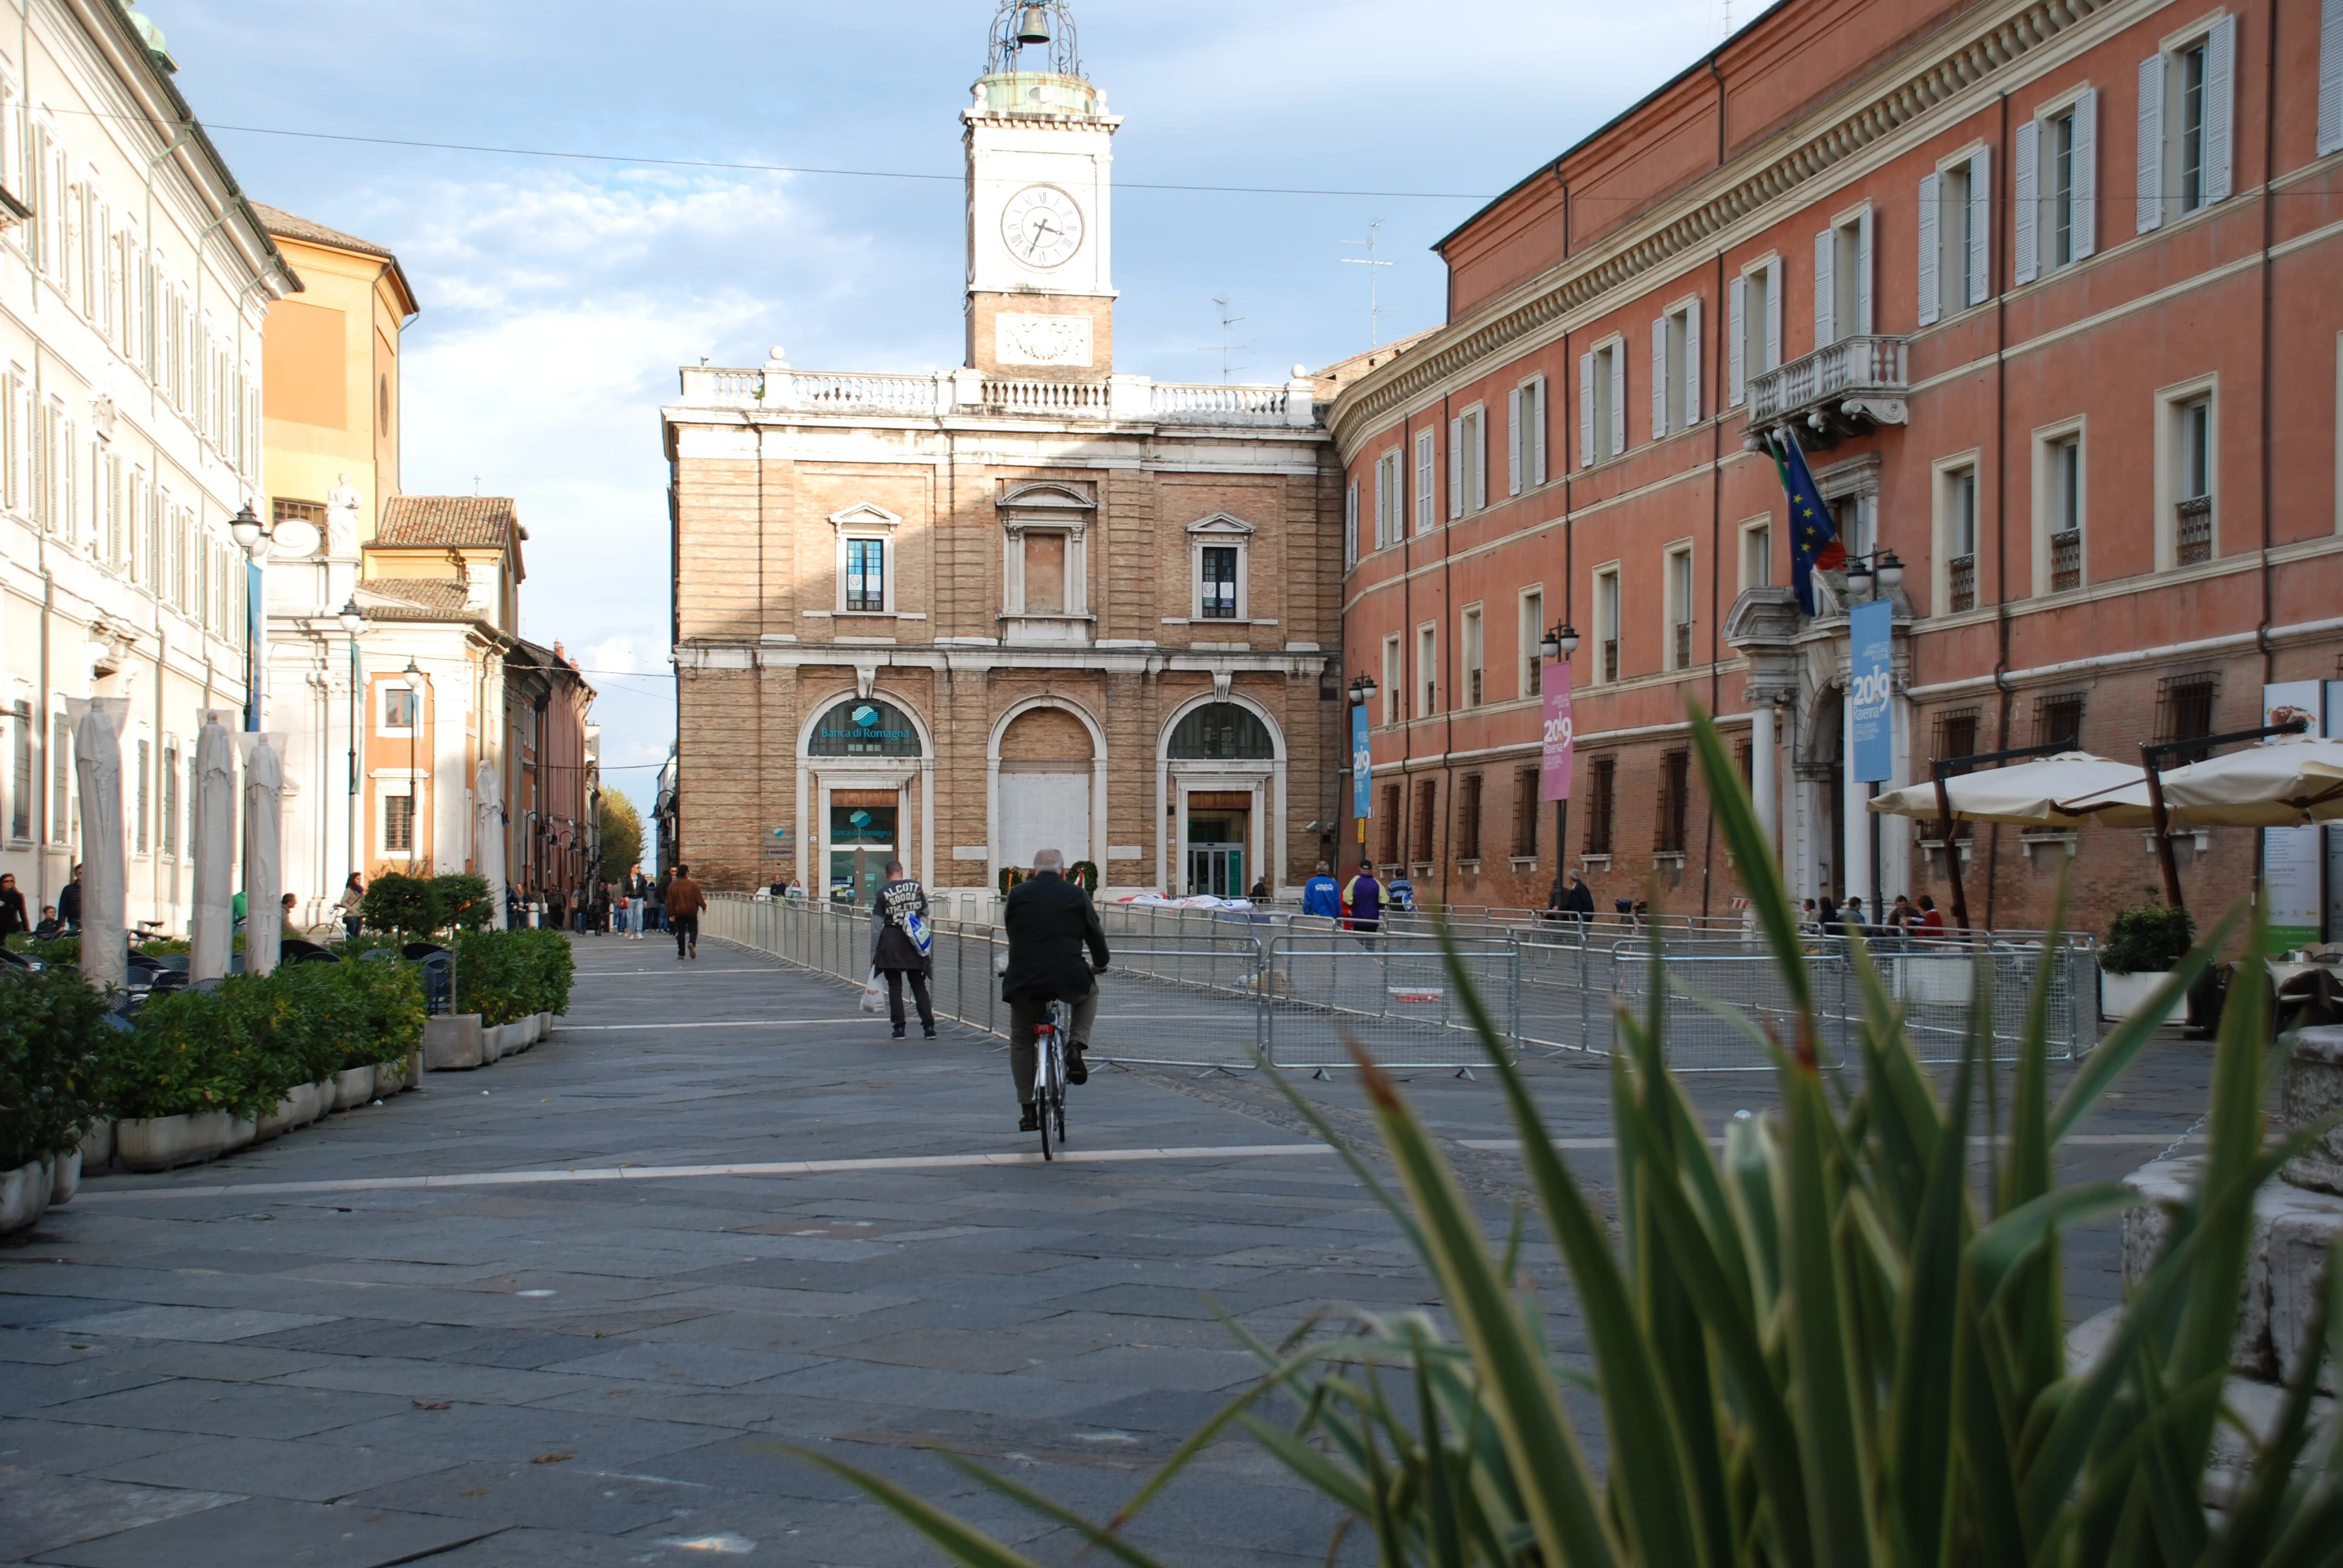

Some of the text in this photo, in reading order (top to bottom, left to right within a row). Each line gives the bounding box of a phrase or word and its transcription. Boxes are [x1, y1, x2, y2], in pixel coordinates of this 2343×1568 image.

[1852, 664, 1890, 713] 2019
[1853, 705, 1879, 720] Ravenna
[821, 728, 909, 740] Banca di Romagna
[1544, 711, 1571, 748] 2019
[859, 829, 891, 838] Romagna
[883, 882, 920, 900] ALCOTT
[889, 892, 916, 905] GOODS
[885, 901, 922, 914] ATHLETICS
